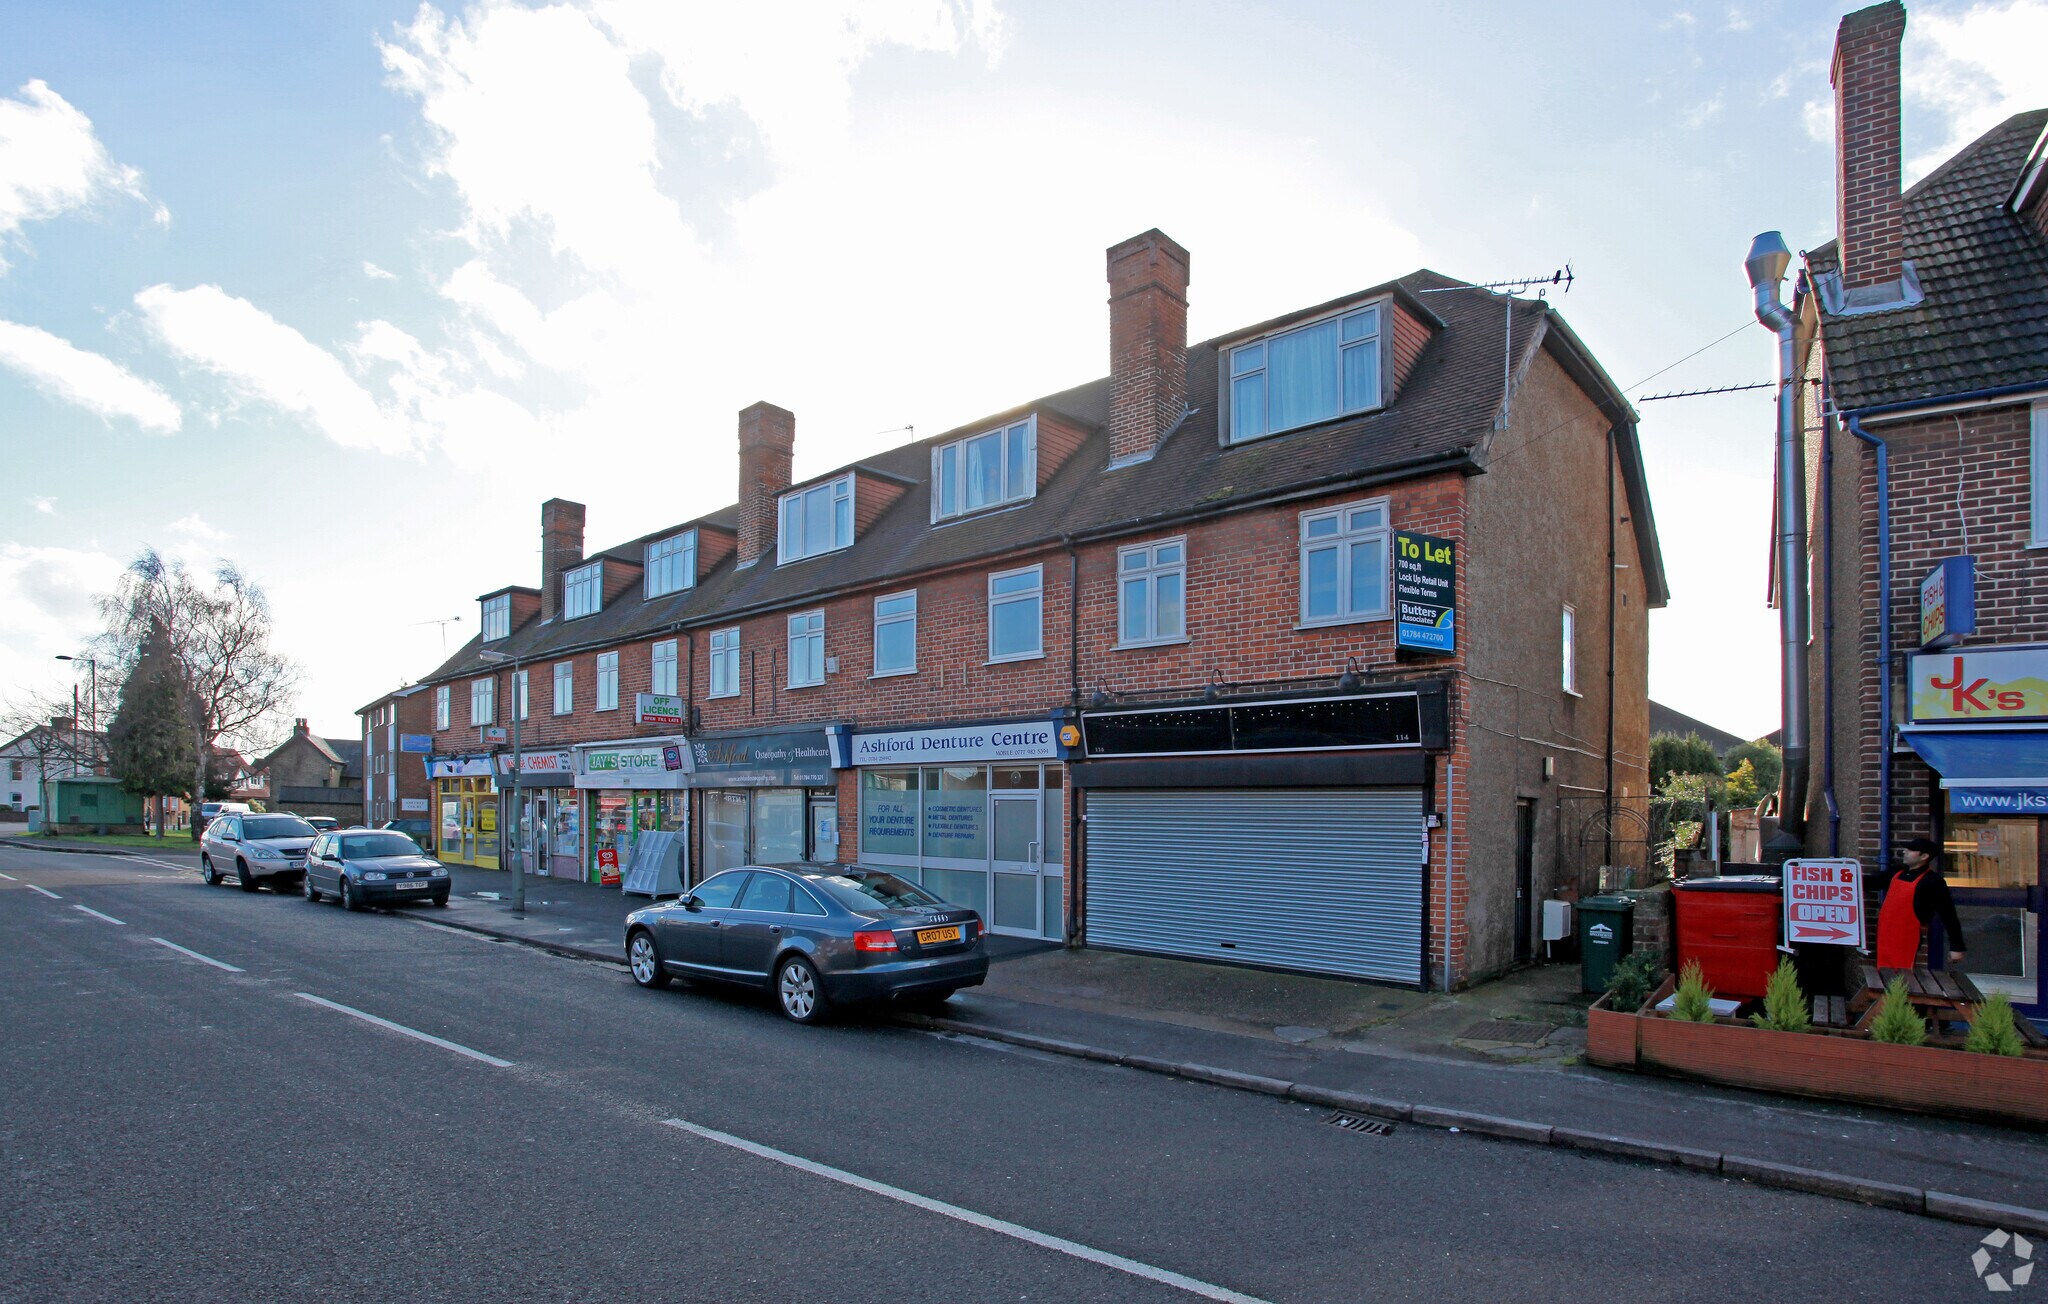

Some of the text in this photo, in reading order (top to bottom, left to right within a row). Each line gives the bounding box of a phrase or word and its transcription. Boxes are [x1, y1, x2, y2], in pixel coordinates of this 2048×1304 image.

[1398, 536, 1452, 565] To Let
[1398, 559, 1409, 569] 700
[1398, 572, 1449, 588] Lock Up Retail Unit
[1398, 584, 1437, 598] Flexible Terms
[1924, 580, 1939, 609] FISH
[1402, 603, 1437, 618] Butters
[1402, 614, 1434, 625] Associates
[1923, 603, 1945, 635] CHIPS
[1402, 629, 1421, 639] 01784
[1422, 632, 1444, 642] 472700
[653, 697, 670, 705] OFF
[643, 706, 679, 715] LICENCE
[860, 731, 1048, 753] Ashford Denture Centre
[527, 756, 558, 769] CHEMIST
[590, 756, 618, 769] JAY'S
[621, 754, 658, 767] STORE
[708, 745, 749, 768] Ashford
[755, 749, 787, 761] Osteopathy
[795, 747, 829, 758] Healthcare
[1961, 793, 2048, 810] www.jks
[869, 816, 915, 824] YOUR DENTURE
[869, 828, 915, 836] REQUIREMENTS
[1792, 867, 1853, 883] FISH &
[1793, 884, 1853, 901] CHIPS
[1798, 905, 1849, 922] OPEN
[921, 928, 957, 942] GR07 USY
